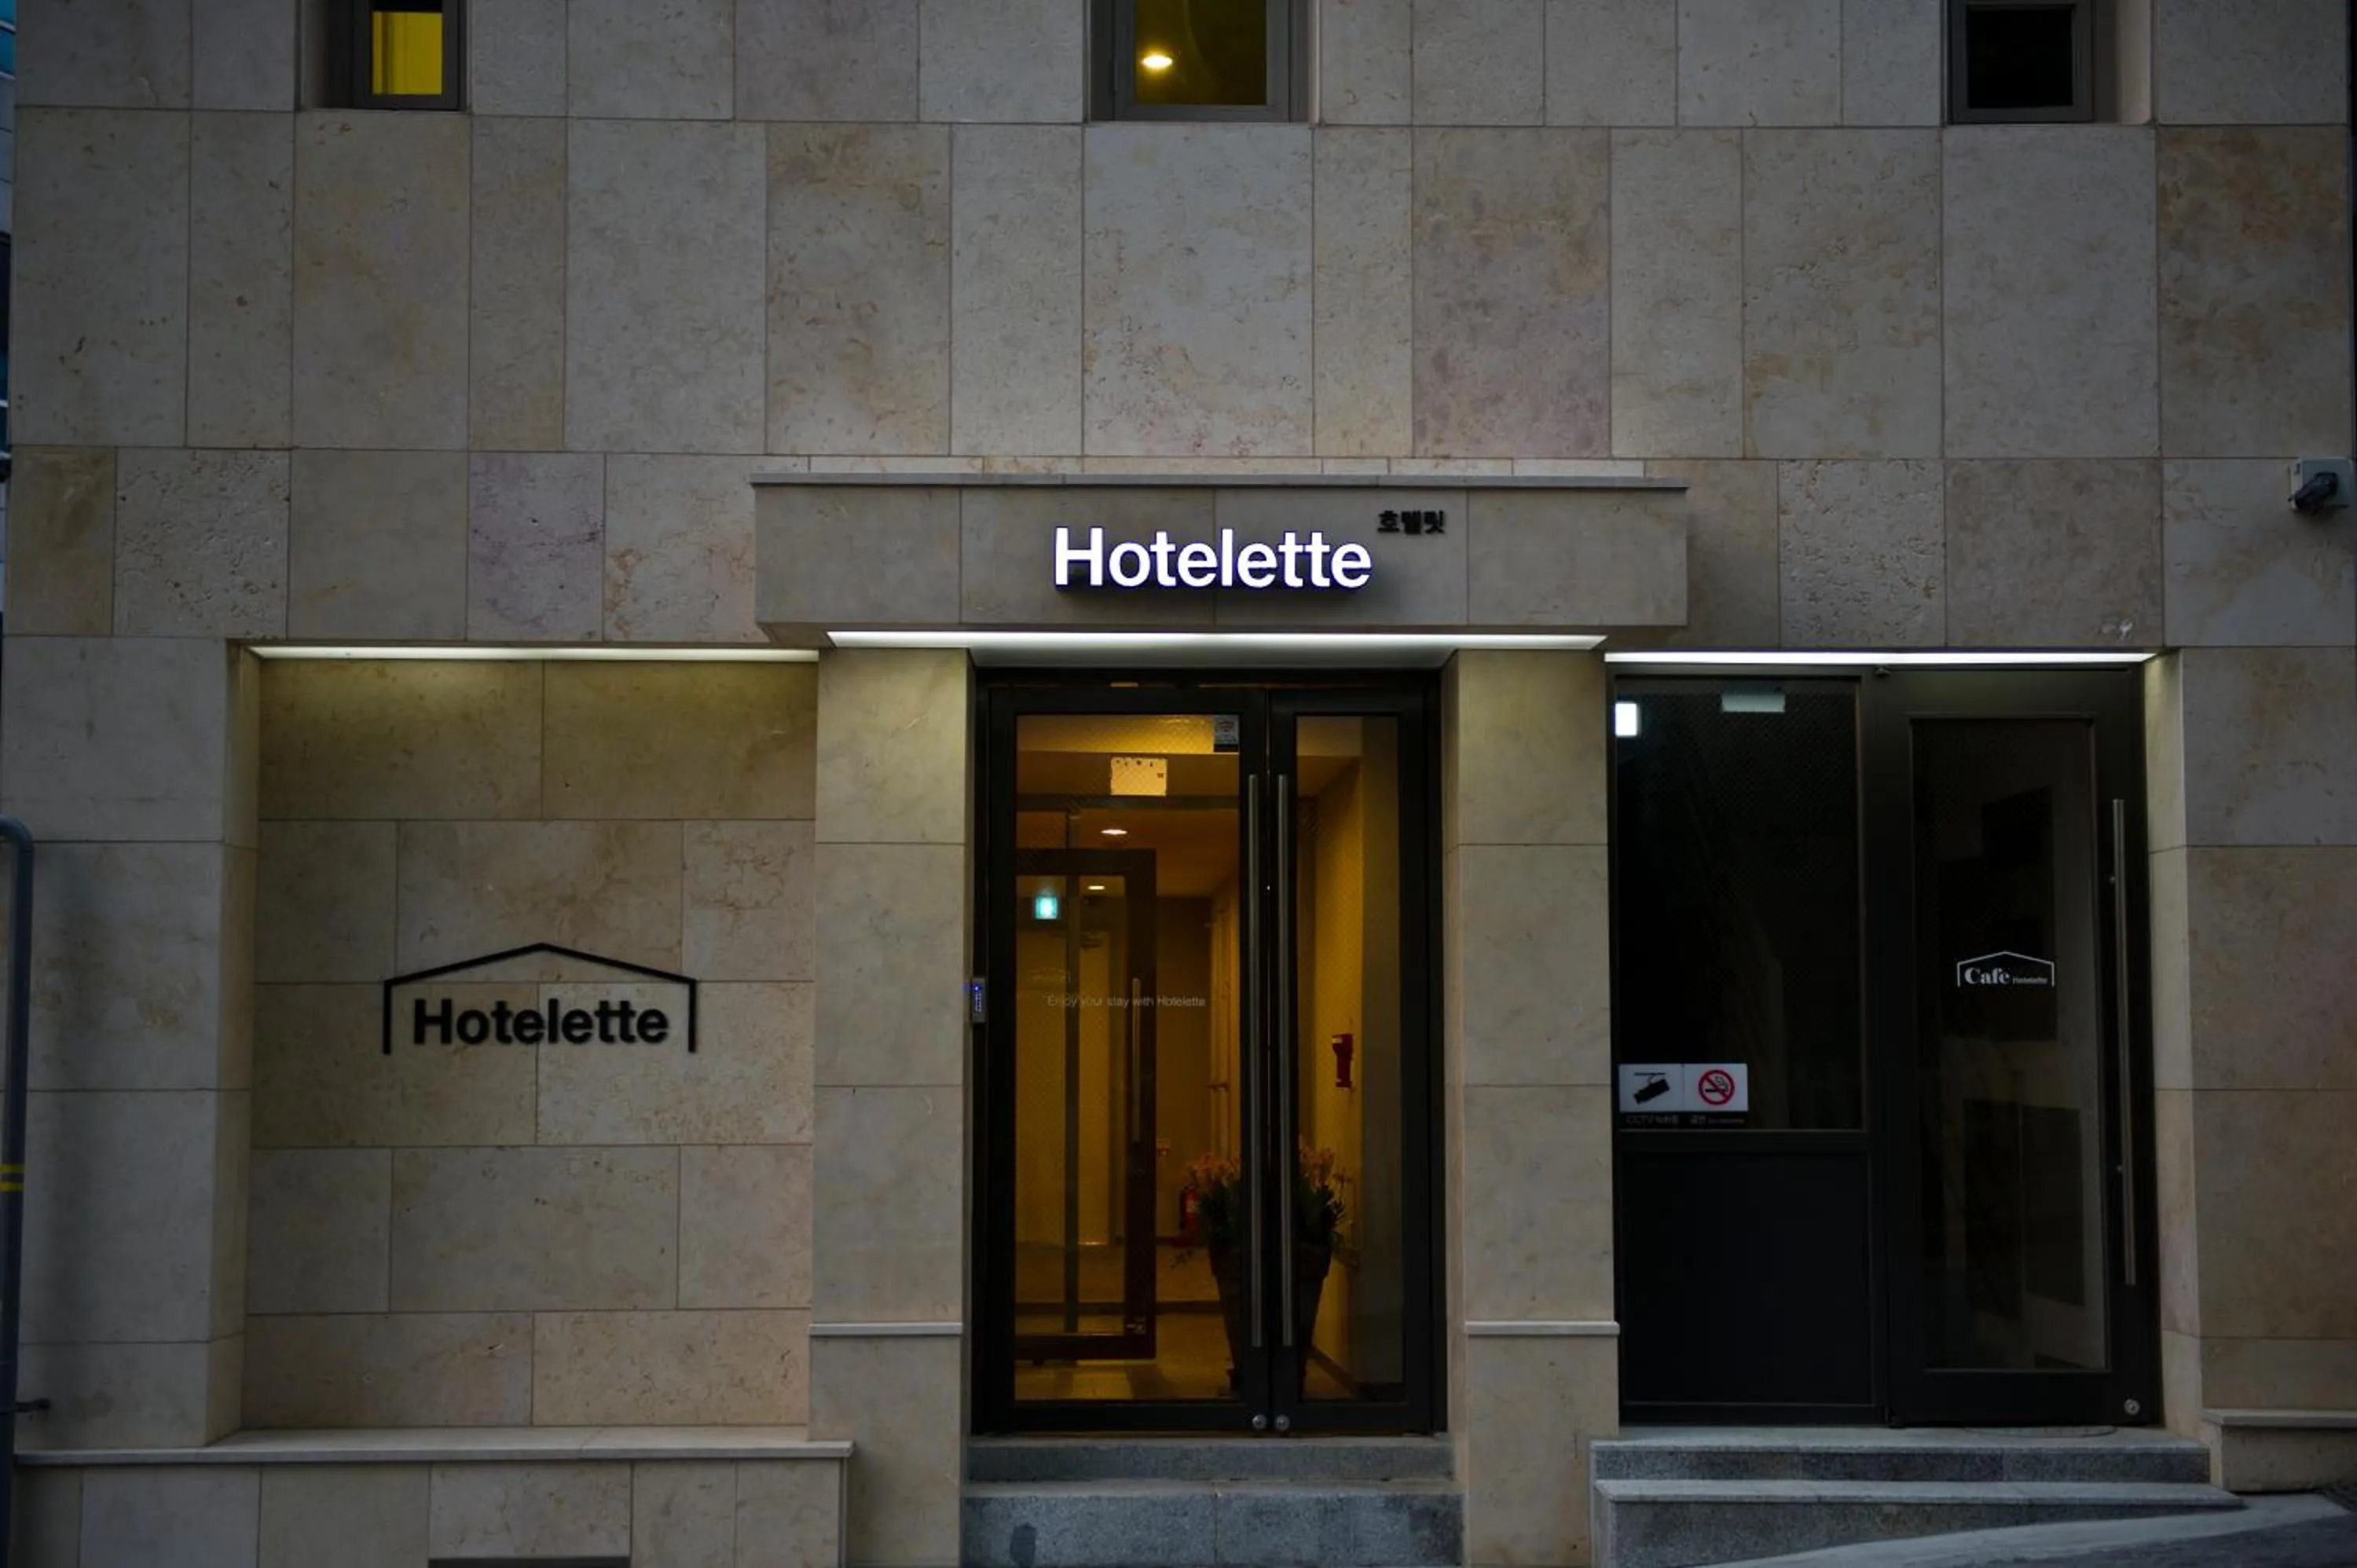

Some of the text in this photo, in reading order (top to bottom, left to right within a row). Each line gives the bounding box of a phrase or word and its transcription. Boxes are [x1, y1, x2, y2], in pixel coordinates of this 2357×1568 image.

[1054, 526, 1372, 588] Hotelette
[1964, 967, 2011, 984] Cafe
[1047, 995, 1077, 1009] Enjoy
[1107, 995, 1129, 1009] stay
[1132, 995, 1155, 1007] with
[1157, 995, 1207, 1007] Hotelette
[413, 998, 669, 1045] Hotelette
[1626, 1114, 1654, 1125] CCTV
